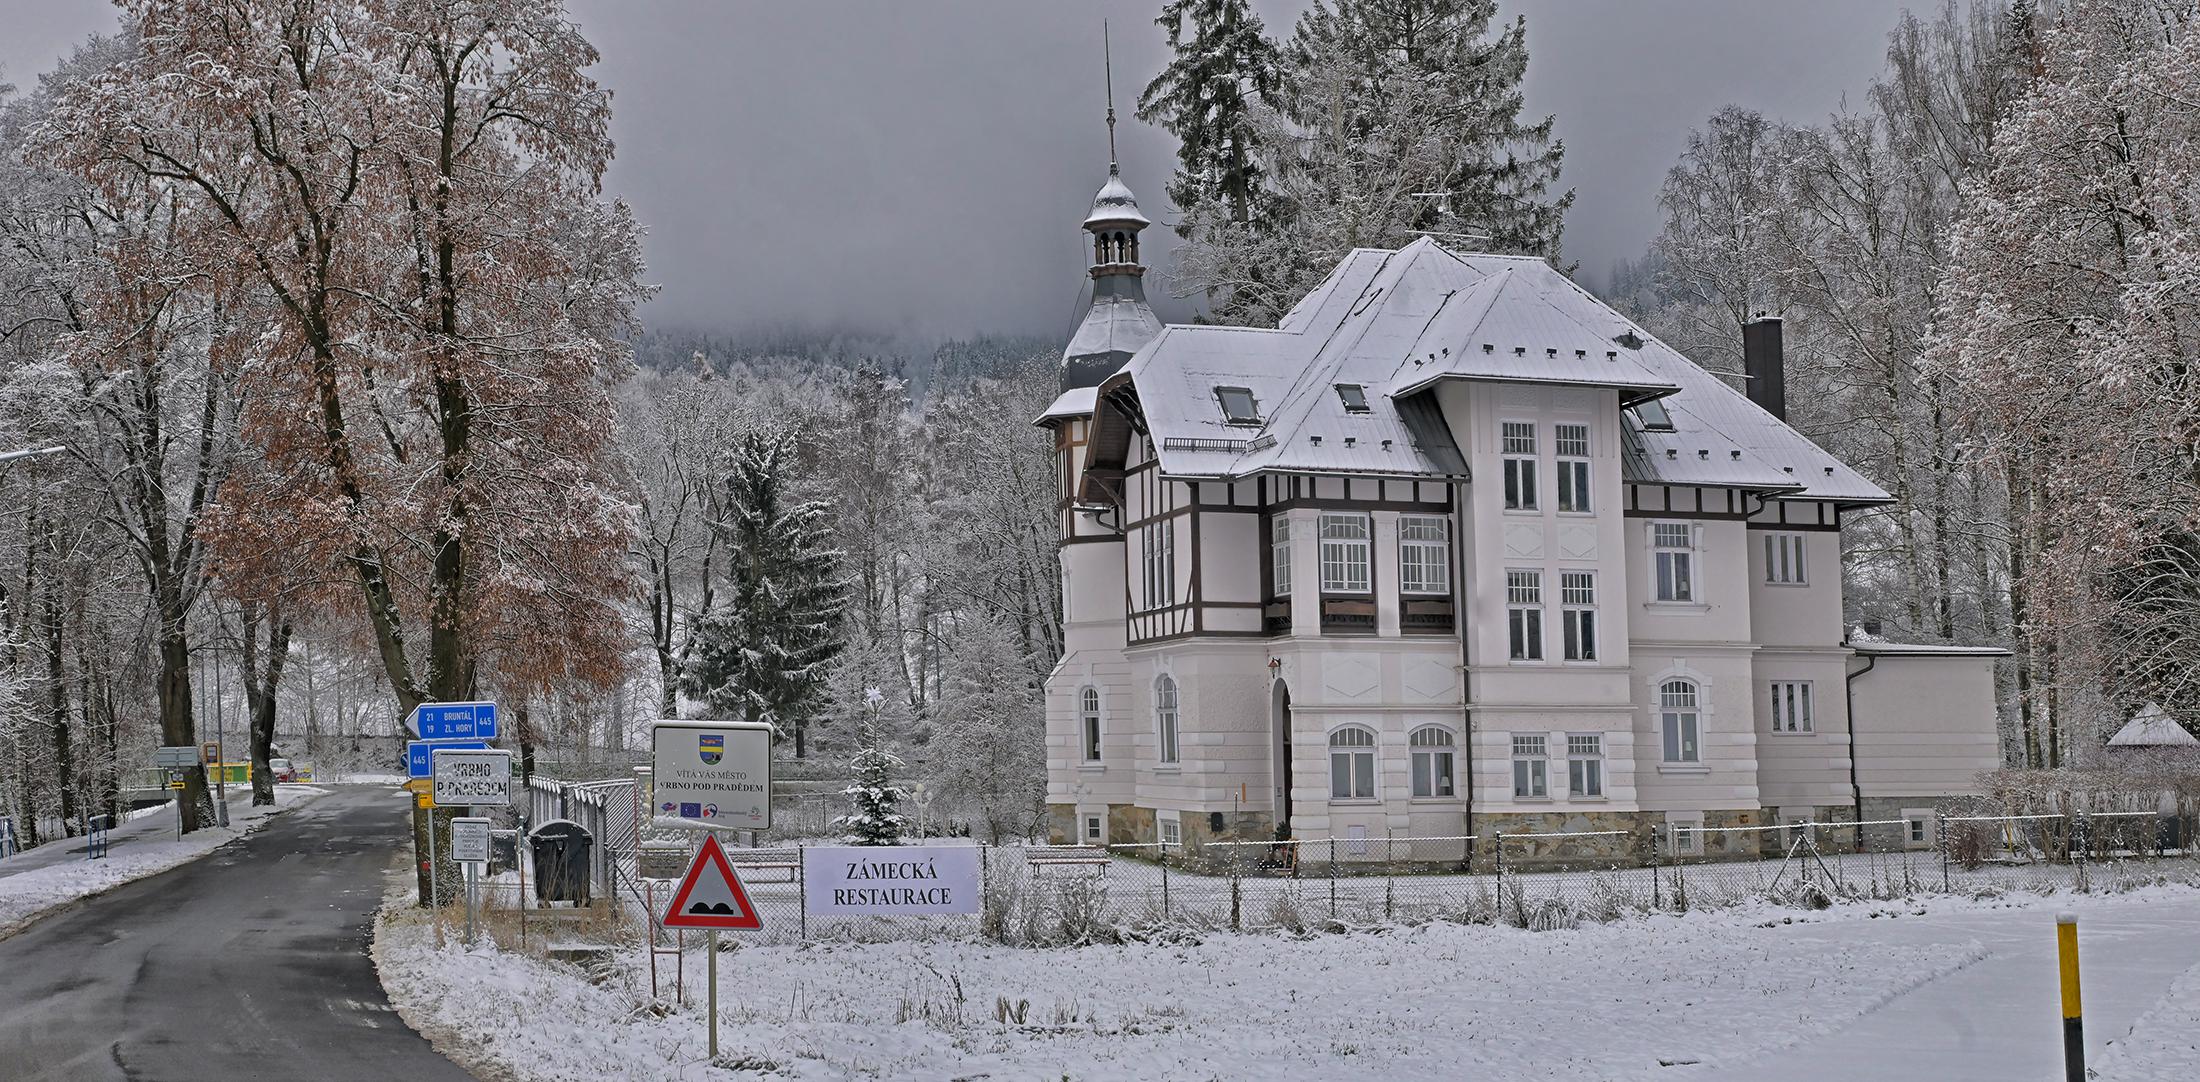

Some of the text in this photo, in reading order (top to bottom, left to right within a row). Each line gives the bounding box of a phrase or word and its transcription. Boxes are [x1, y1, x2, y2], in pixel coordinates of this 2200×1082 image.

[426, 710, 472, 722] 21 BRUNTÁL
[479, 718, 492, 726] 445
[427, 724, 473, 734] 19 ZL. HORY
[413, 756, 425, 765] 445
[453, 763, 491, 777] VRBNO
[676, 769, 747, 780] VÍTÁ VÁS MĚSTO
[437, 782, 446, 796] P.
[660, 781, 764, 792] VRBNO POD PRADĚDEM
[846, 857, 938, 880] ZÁMECKÁ
[833, 887, 952, 906] RESTAURACE
